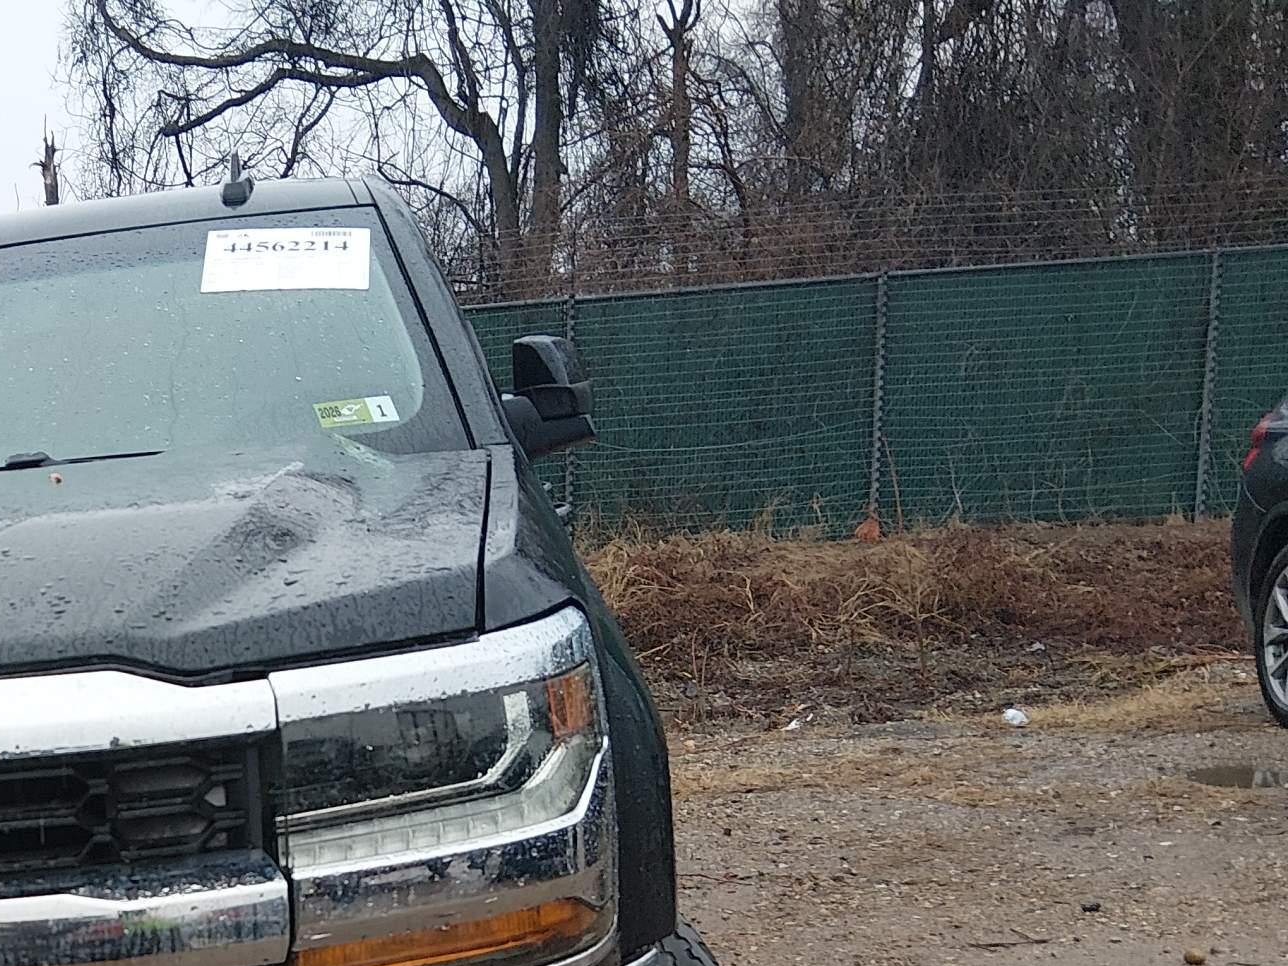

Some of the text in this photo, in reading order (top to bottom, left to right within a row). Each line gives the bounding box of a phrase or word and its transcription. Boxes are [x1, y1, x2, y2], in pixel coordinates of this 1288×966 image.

[223, 240, 350, 254] 44562214
[318, 404, 387, 419] 2026 1
